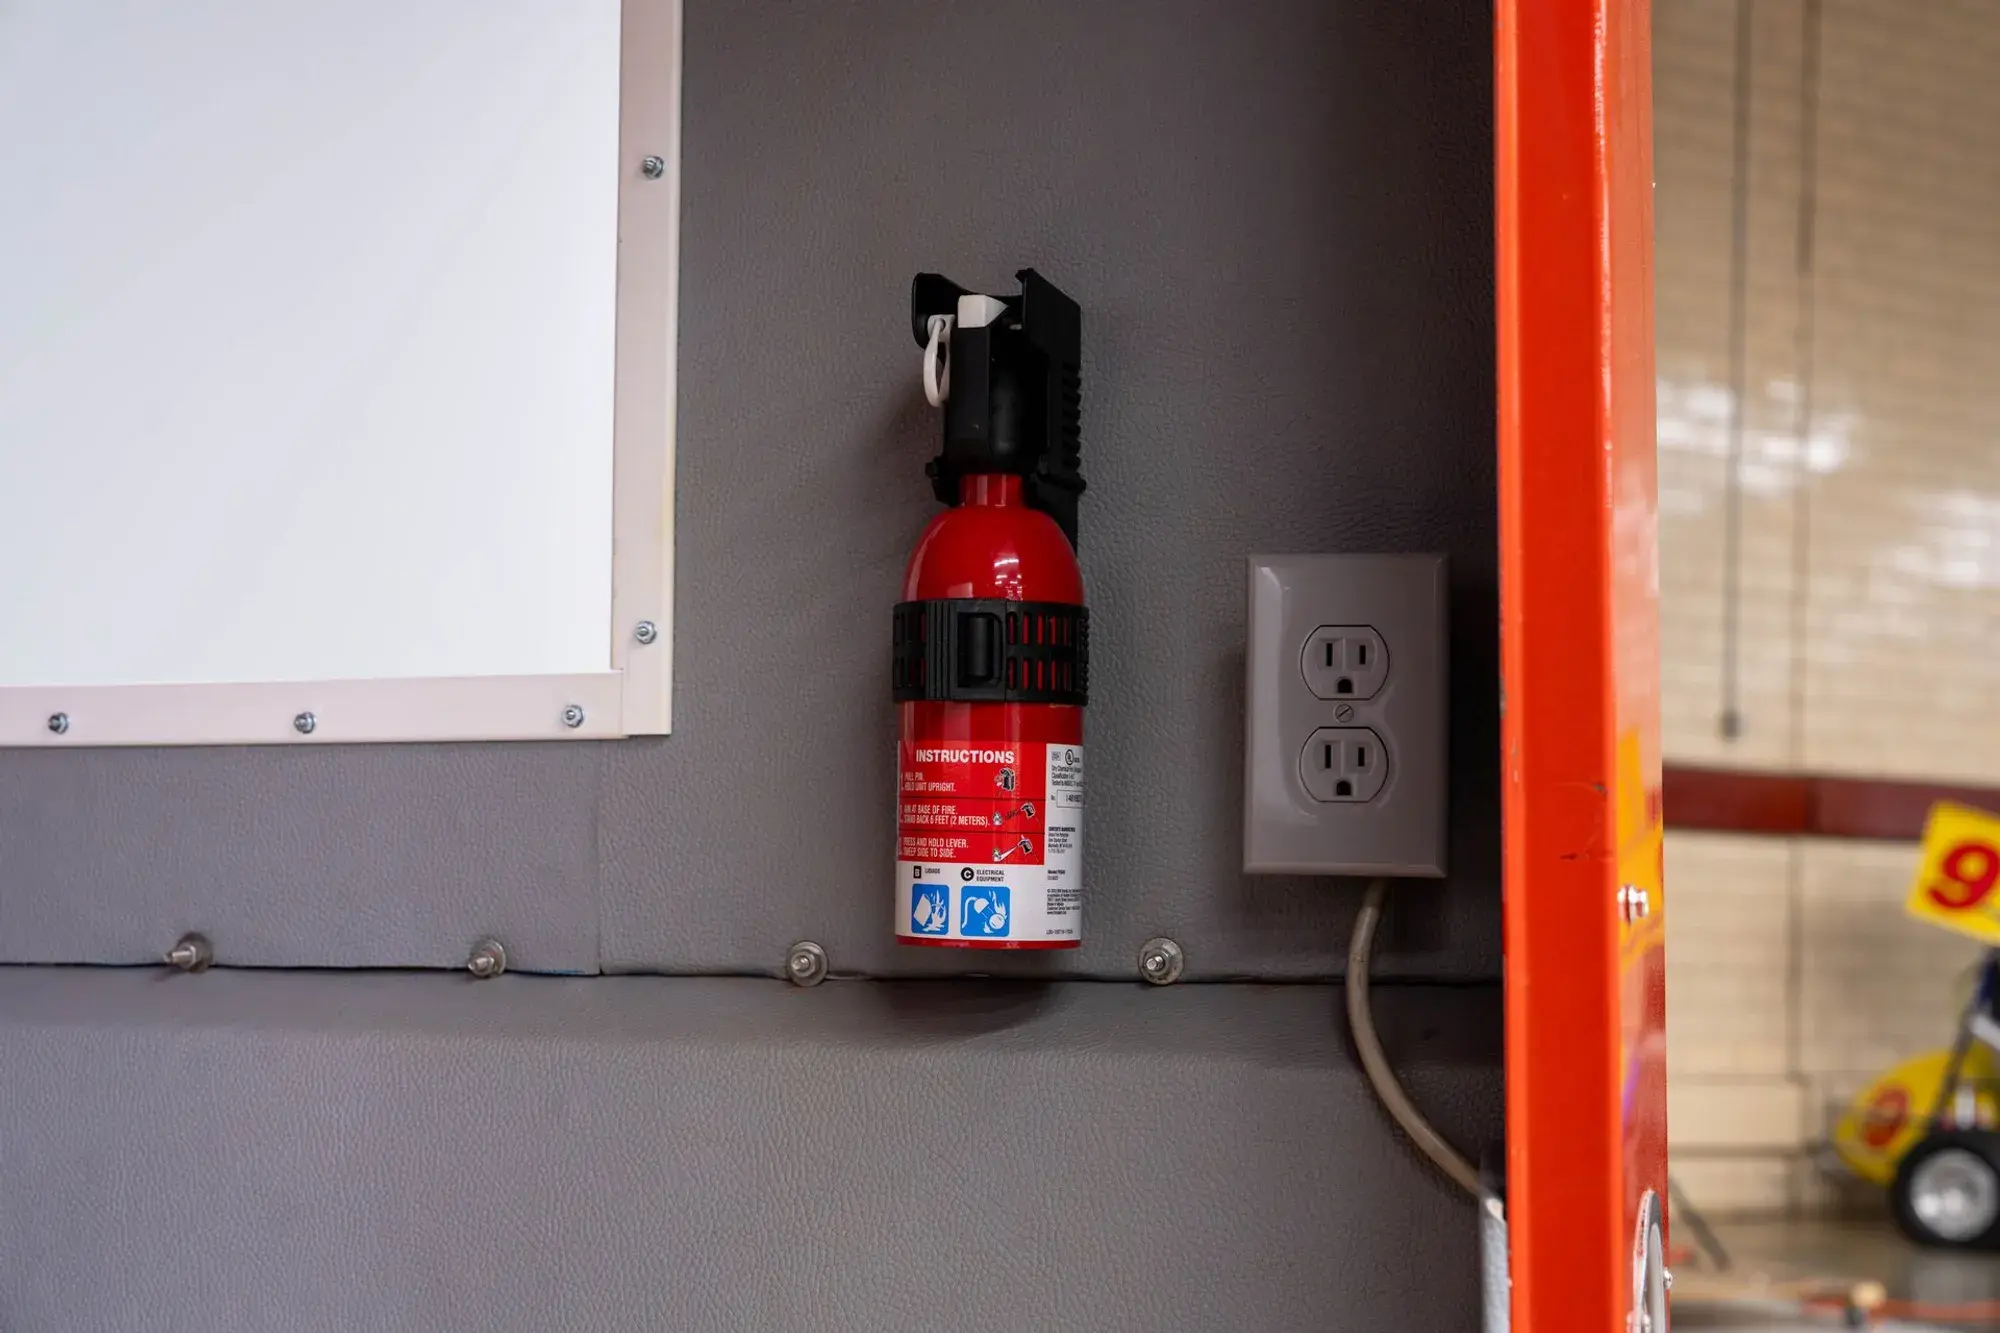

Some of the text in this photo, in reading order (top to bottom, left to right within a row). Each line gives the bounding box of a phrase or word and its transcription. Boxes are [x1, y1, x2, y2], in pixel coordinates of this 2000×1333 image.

[916, 750, 1014, 764] INSTRUCTIONS
[928, 783, 956, 792] UPRIGHT.
[918, 805, 930, 814] BASE
[932, 805, 940, 814] OF
[942, 805, 958, 814] FIRE.
[916, 815, 929, 824] BACK
[930, 815, 934, 824] 6
[935, 815, 948, 824] FEET
[950, 815, 957, 826] (2
[958, 816, 990, 827] METERS).
[916, 837, 927, 846] AND
[928, 838, 944, 847] HOLD
[946, 838, 968, 848] LEVER.
[917, 847, 928, 857] SIDE
[930, 848, 938, 858] TO
[940, 848, 956, 858] SIDE.
[1926, 843, 2000, 909] 9
